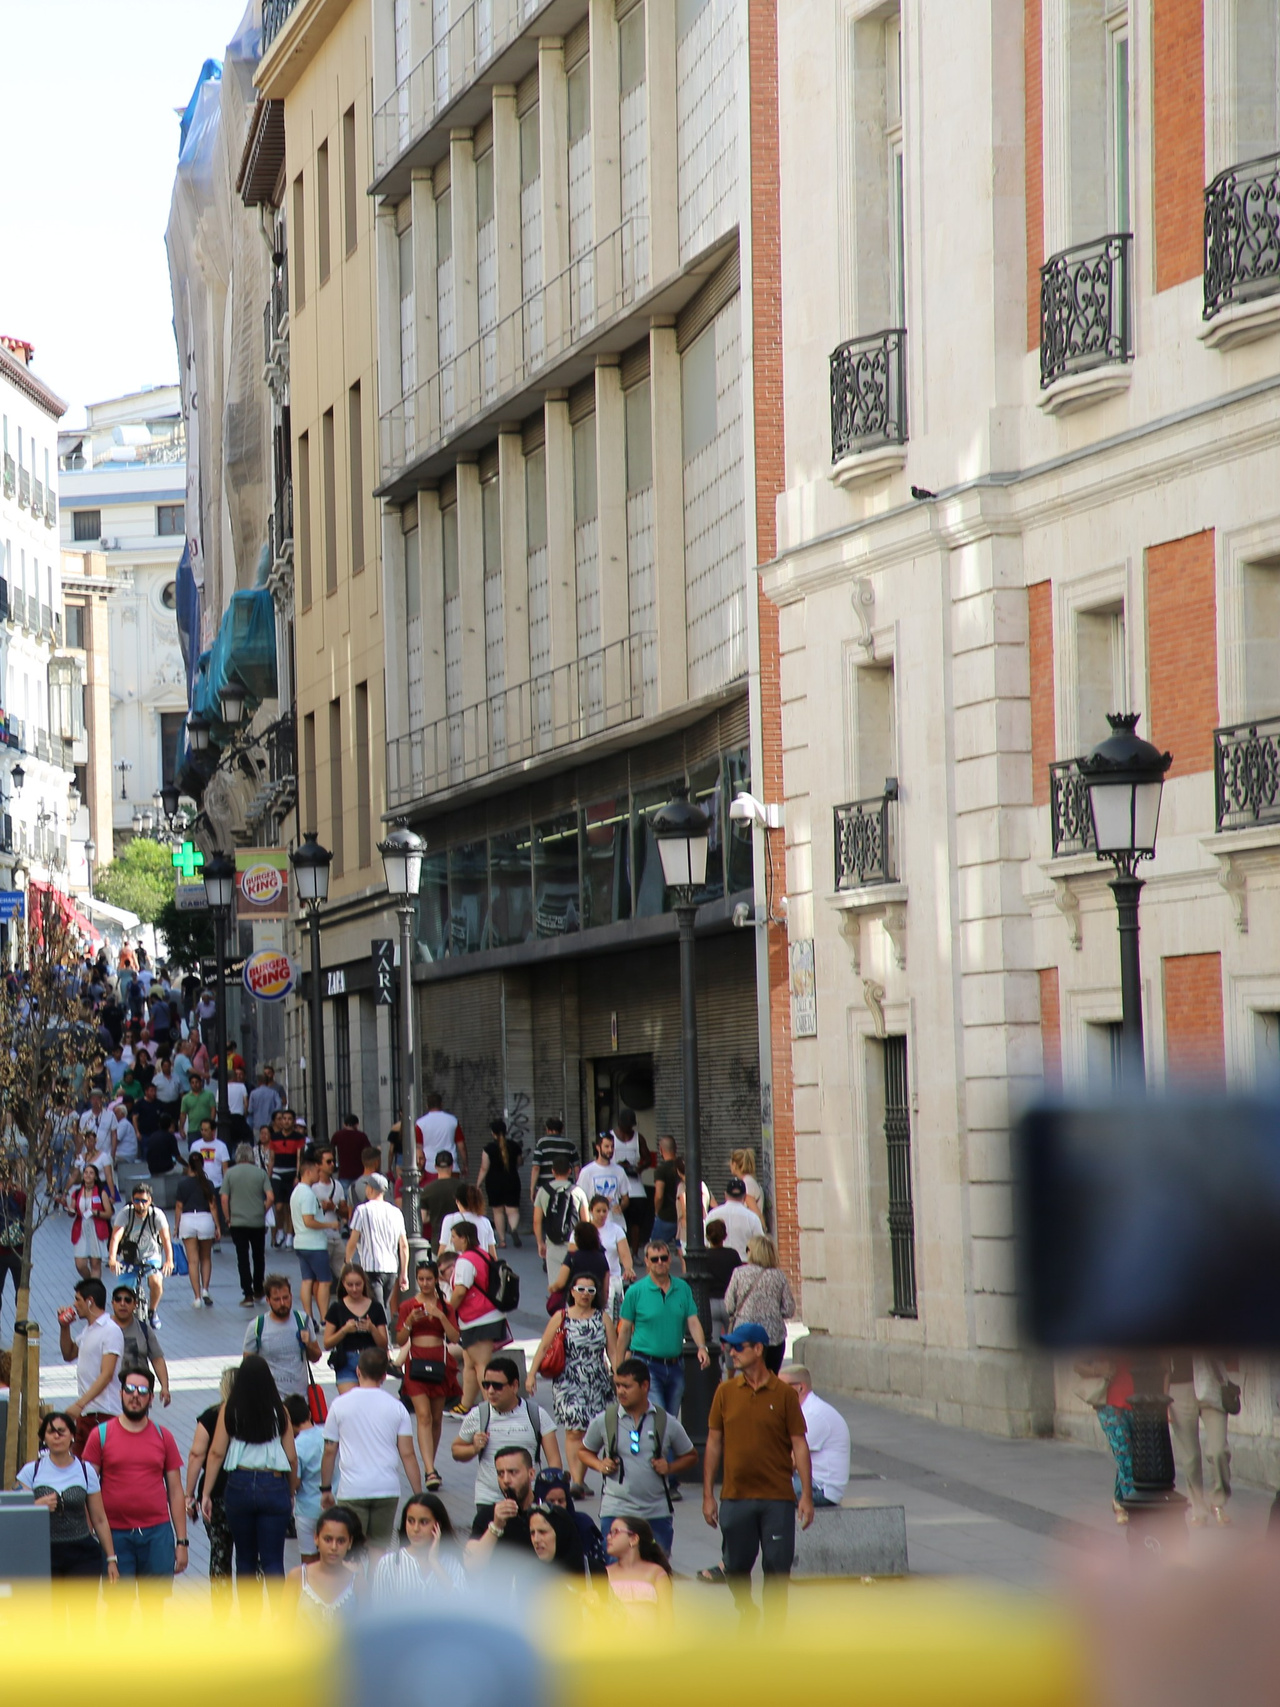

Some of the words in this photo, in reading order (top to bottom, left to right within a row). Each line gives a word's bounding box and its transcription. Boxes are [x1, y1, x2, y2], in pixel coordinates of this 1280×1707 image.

[246, 870, 276, 886] BURGER
[248, 878, 278, 896] KING
[249, 958, 288, 979] BURGER
[377, 941, 394, 1003] ZARA
[251, 970, 290, 992] KING
